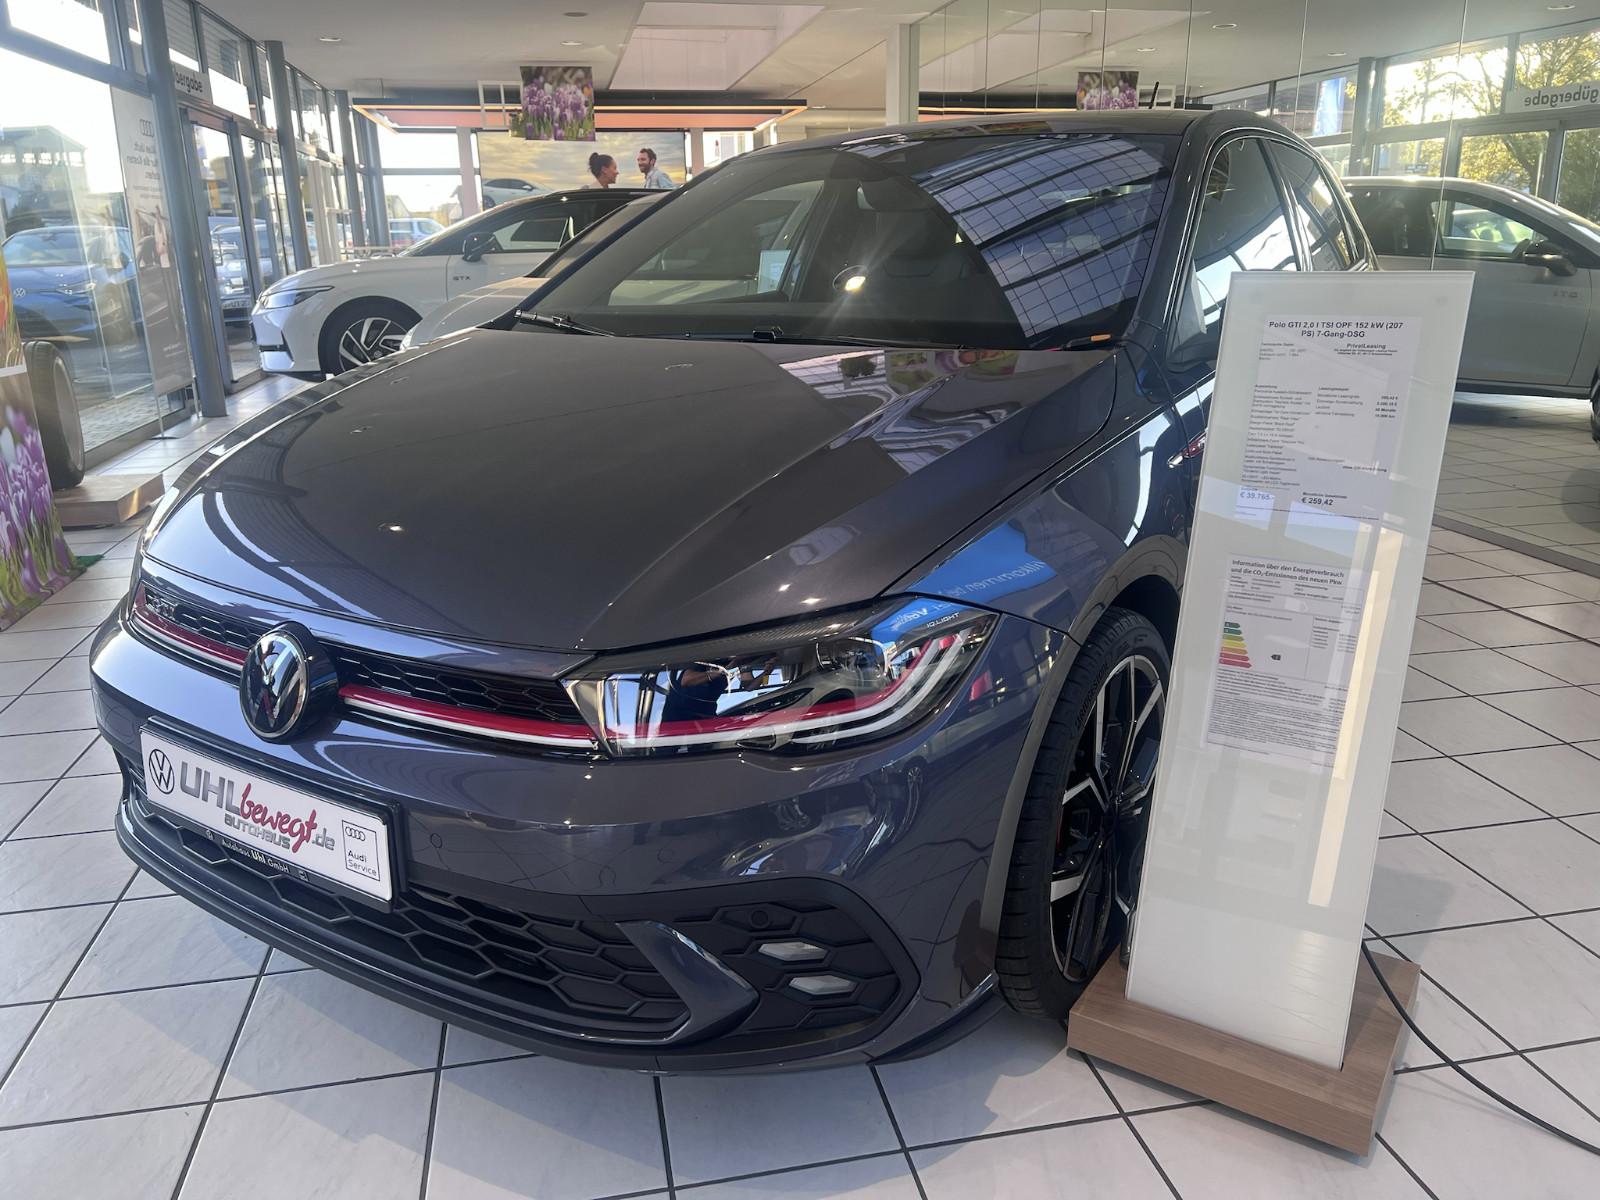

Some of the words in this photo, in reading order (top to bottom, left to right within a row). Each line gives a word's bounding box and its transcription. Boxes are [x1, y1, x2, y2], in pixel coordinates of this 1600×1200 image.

[1269, 321, 1286, 329] Polo
[1287, 321, 1301, 329] GTI
[1321, 321, 1334, 329] TSI
[1335, 322, 1353, 330] OPF
[1355, 321, 1369, 329] 152
[1371, 321, 1384, 329] kW
[1385, 321, 1404, 331] (207
[1301, 330, 1315, 338] PS)
[1317, 330, 1365, 339] 7-Gang-DSG
[1232, 559, 1266, 569] Information
[1266, 561, 1280, 570] über
[1280, 564, 1292, 572] den
[1292, 566, 1345, 578] Energieverbrauch
[1298, 573, 1309, 581] des
[1309, 576, 1328, 584] neuen
[1329, 578, 1343, 586] Pkw
[347, 850, 367, 863] Audi
[348, 858, 377, 877] Service
